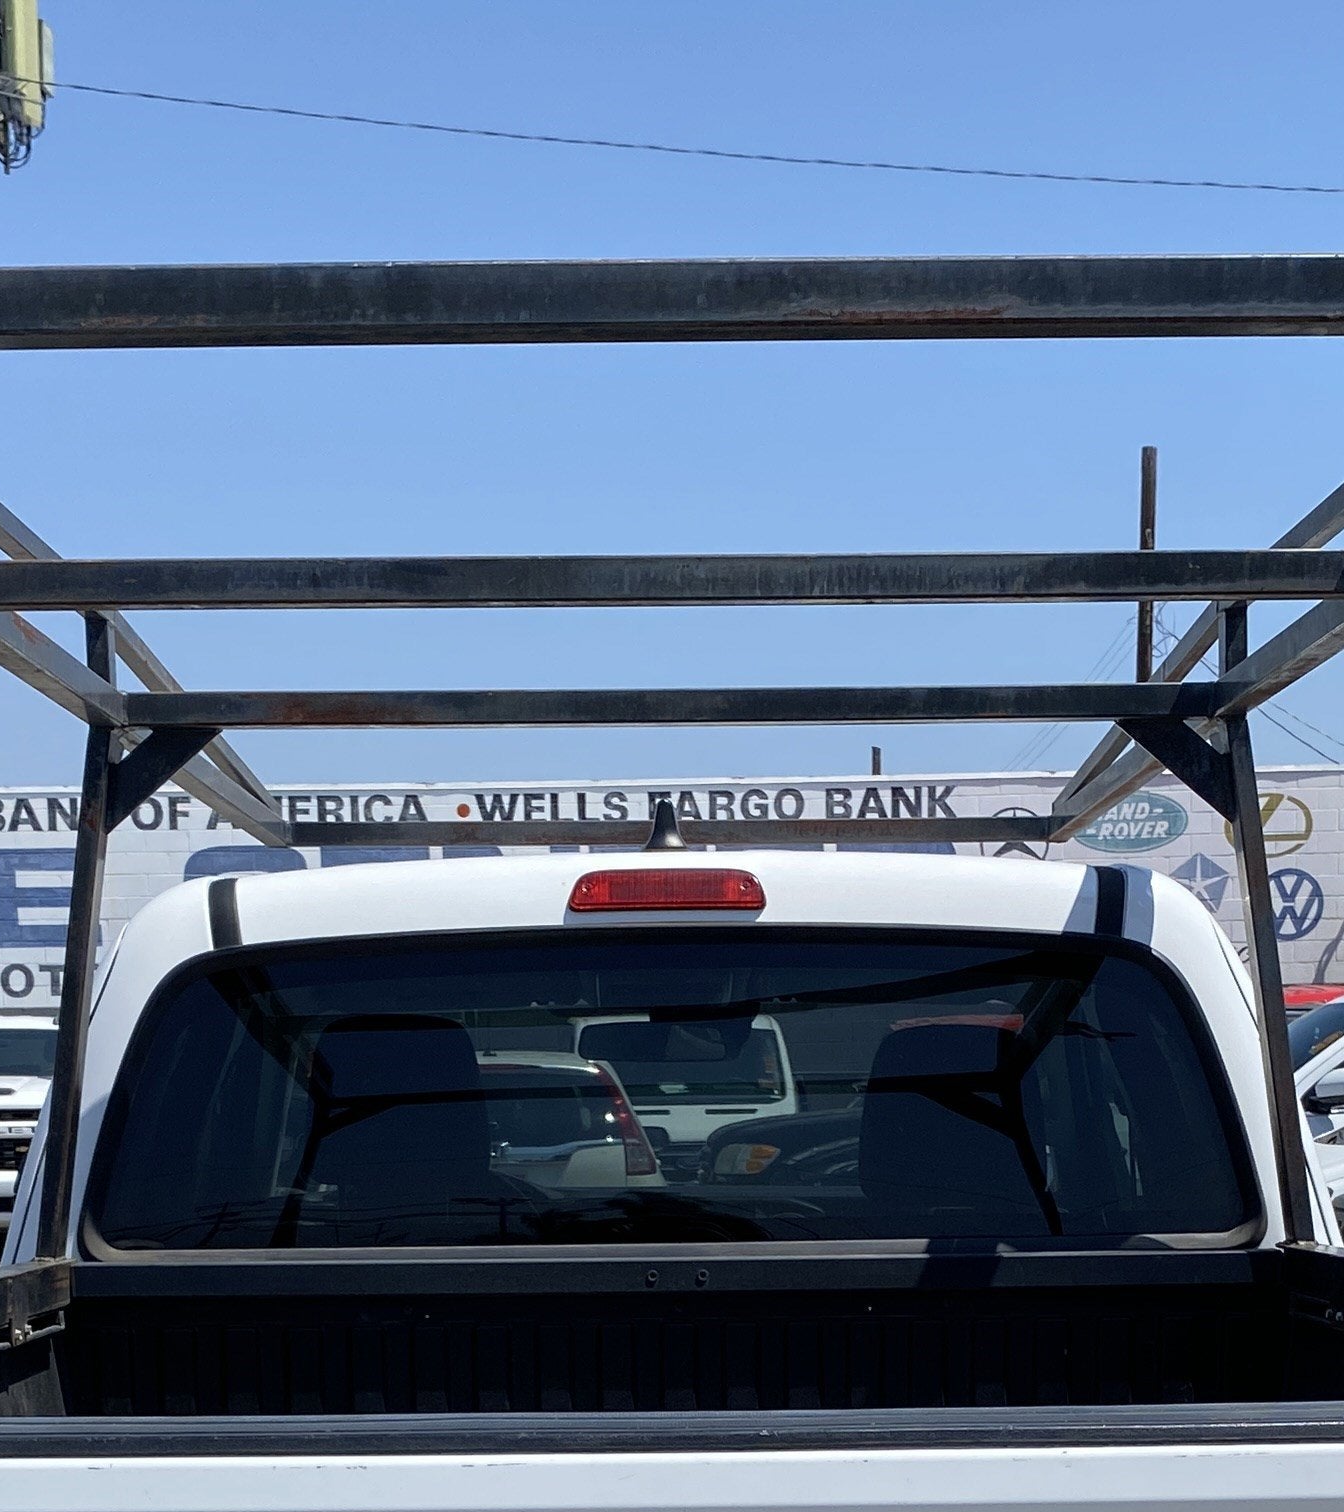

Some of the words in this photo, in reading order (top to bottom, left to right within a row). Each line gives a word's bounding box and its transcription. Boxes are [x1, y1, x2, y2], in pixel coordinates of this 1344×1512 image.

[131, 796, 192, 831] OF
[207, 794, 429, 830] ERICA
[474, 792, 629, 822] WELLS
[824, 785, 957, 819] BANK
[1097, 802, 1164, 821] AND-
